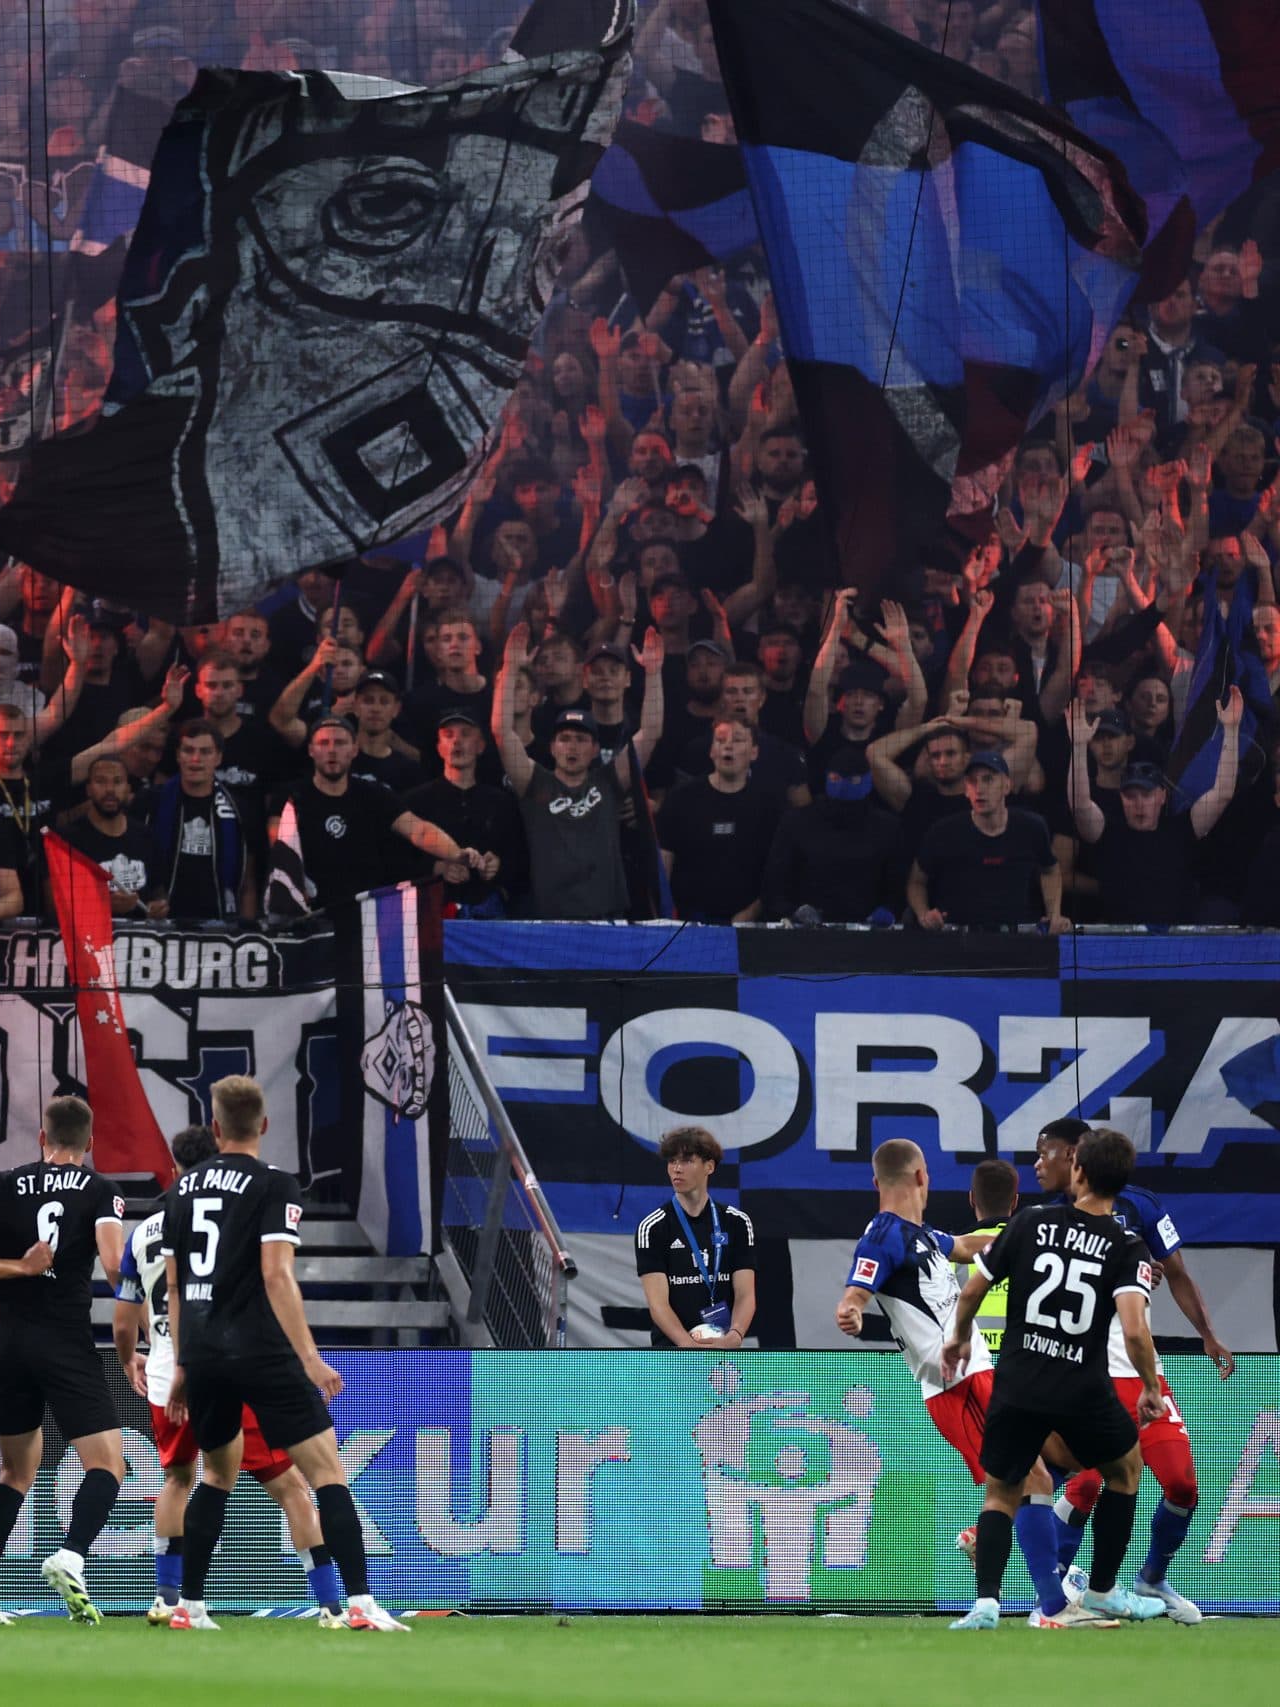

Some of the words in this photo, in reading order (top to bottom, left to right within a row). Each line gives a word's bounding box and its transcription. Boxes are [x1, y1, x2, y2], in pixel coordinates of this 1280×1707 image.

[14, 936, 269, 989] HBURG
[16, 1174, 41, 1196] ST.
[43, 1171, 92, 1193] PAULI
[178, 1171, 200, 1197] ST.
[202, 1168, 253, 1195] PAULI
[36, 1200, 65, 1259] 6
[188, 1196, 223, 1277] 5
[1036, 1223, 1060, 1248] ST.
[185, 1284, 213, 1302] WAHL
[669, 1271, 731, 1286] Hanseeku
[1025, 1251, 1103, 1336] 25
